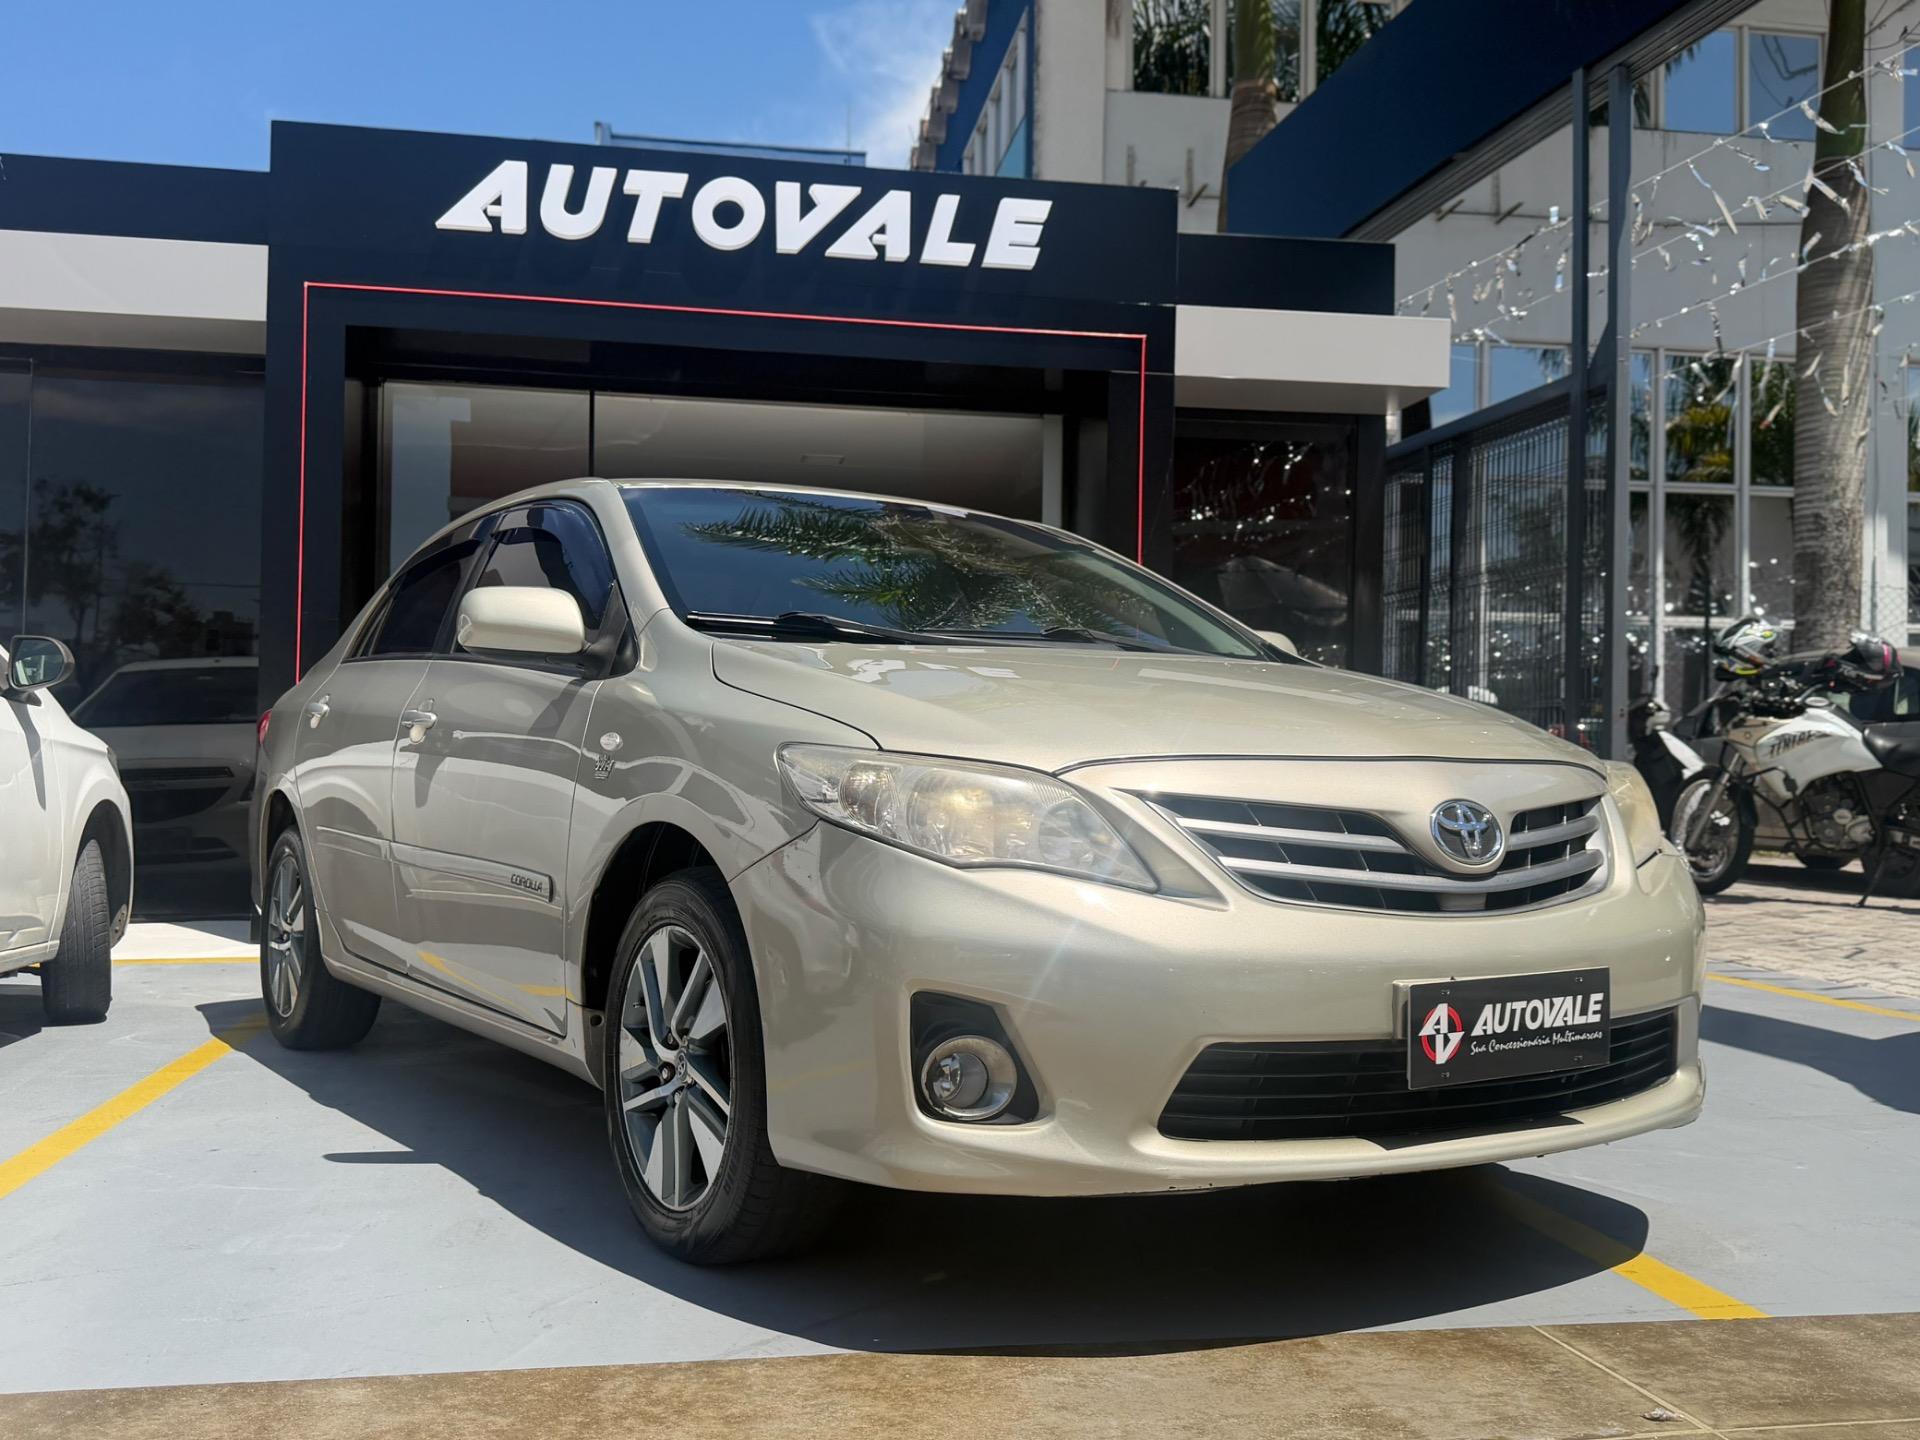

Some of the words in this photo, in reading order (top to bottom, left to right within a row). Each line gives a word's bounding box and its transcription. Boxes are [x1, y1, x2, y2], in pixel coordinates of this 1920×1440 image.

[435, 160, 1053, 270] AUTOVALE
[511, 874, 542, 892] COROLLA
[1471, 992, 1604, 1036] AUTOVALE
[1471, 1041, 1487, 1055] Sua
[1552, 1030, 1603, 1045] Multimarcas
